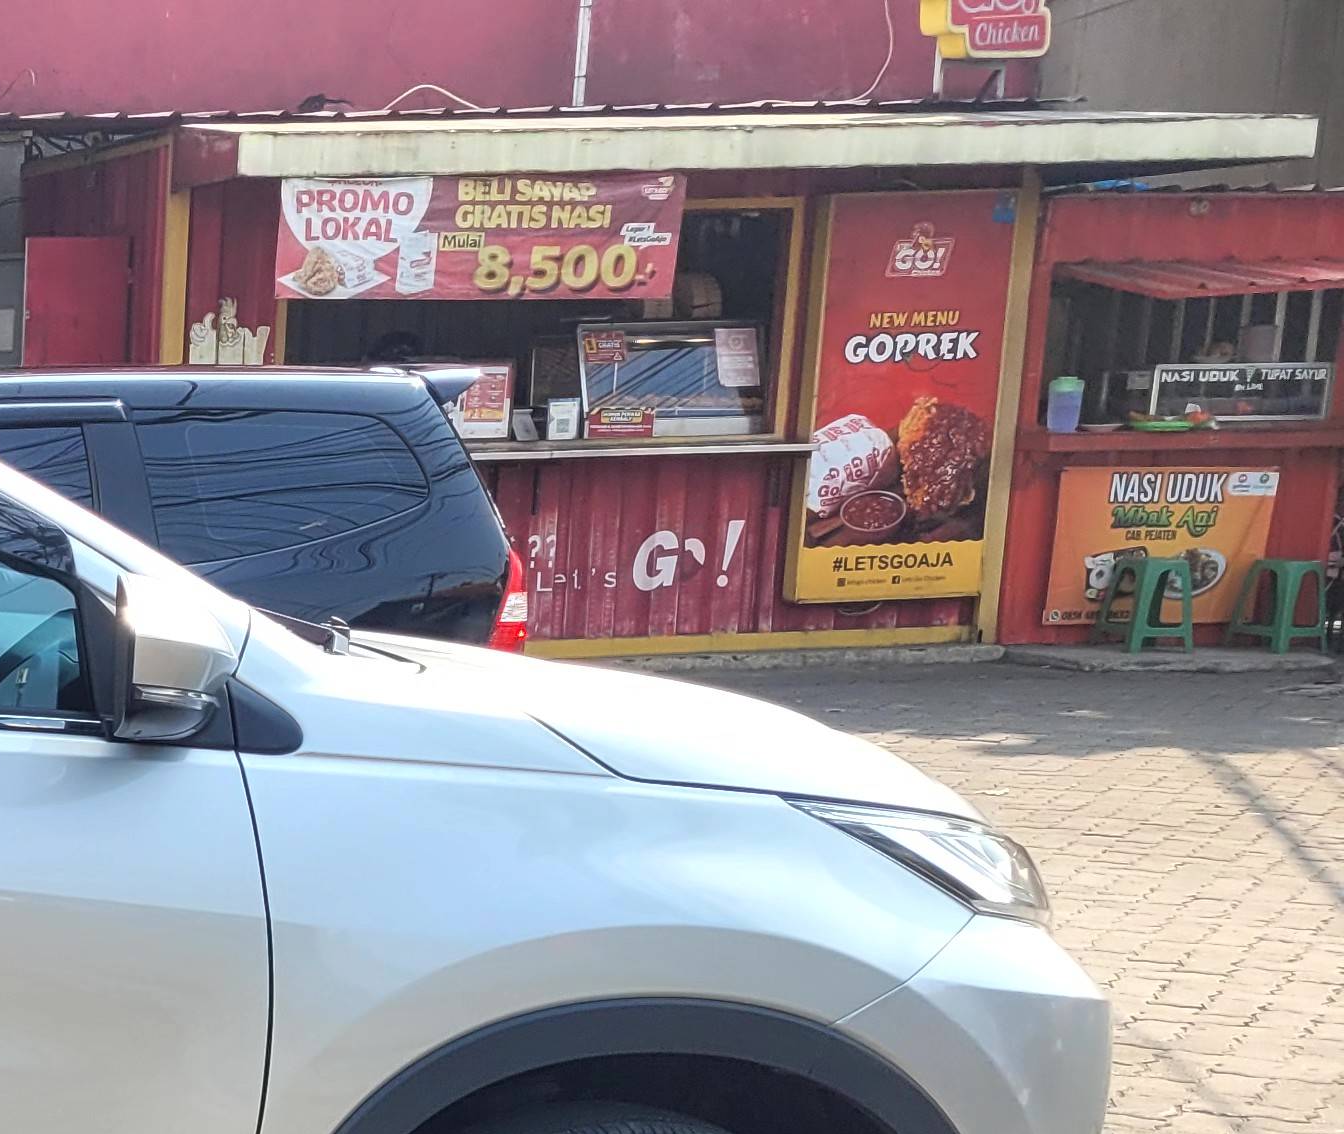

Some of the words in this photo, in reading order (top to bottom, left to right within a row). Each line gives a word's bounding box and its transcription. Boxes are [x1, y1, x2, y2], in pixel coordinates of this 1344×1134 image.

[974, 21, 1040, 46] Chicken
[456, 177, 512, 201] BELI
[515, 178, 598, 201] SAYAP
[295, 188, 415, 216] PROMO
[454, 204, 548, 229] GRATIS
[550, 204, 612, 229] NASI
[305, 216, 398, 243] LOKAL
[442, 233, 483, 249] Mulai
[895, 247, 946, 270] GO!
[869, 312, 908, 328] NEW
[910, 310, 960, 327] MENU
[844, 330, 980, 364] GOPREK
[1160, 370, 1194, 383] NASI
[1198, 369, 1240, 382] UDUK
[1295, 368, 1328, 381] SAYUR
[1109, 472, 1162, 504] NASI
[1166, 472, 1228, 504] UDUK
[1111, 505, 1174, 528] Mbak
[832, 551, 954, 573] #LETSGOAJA
